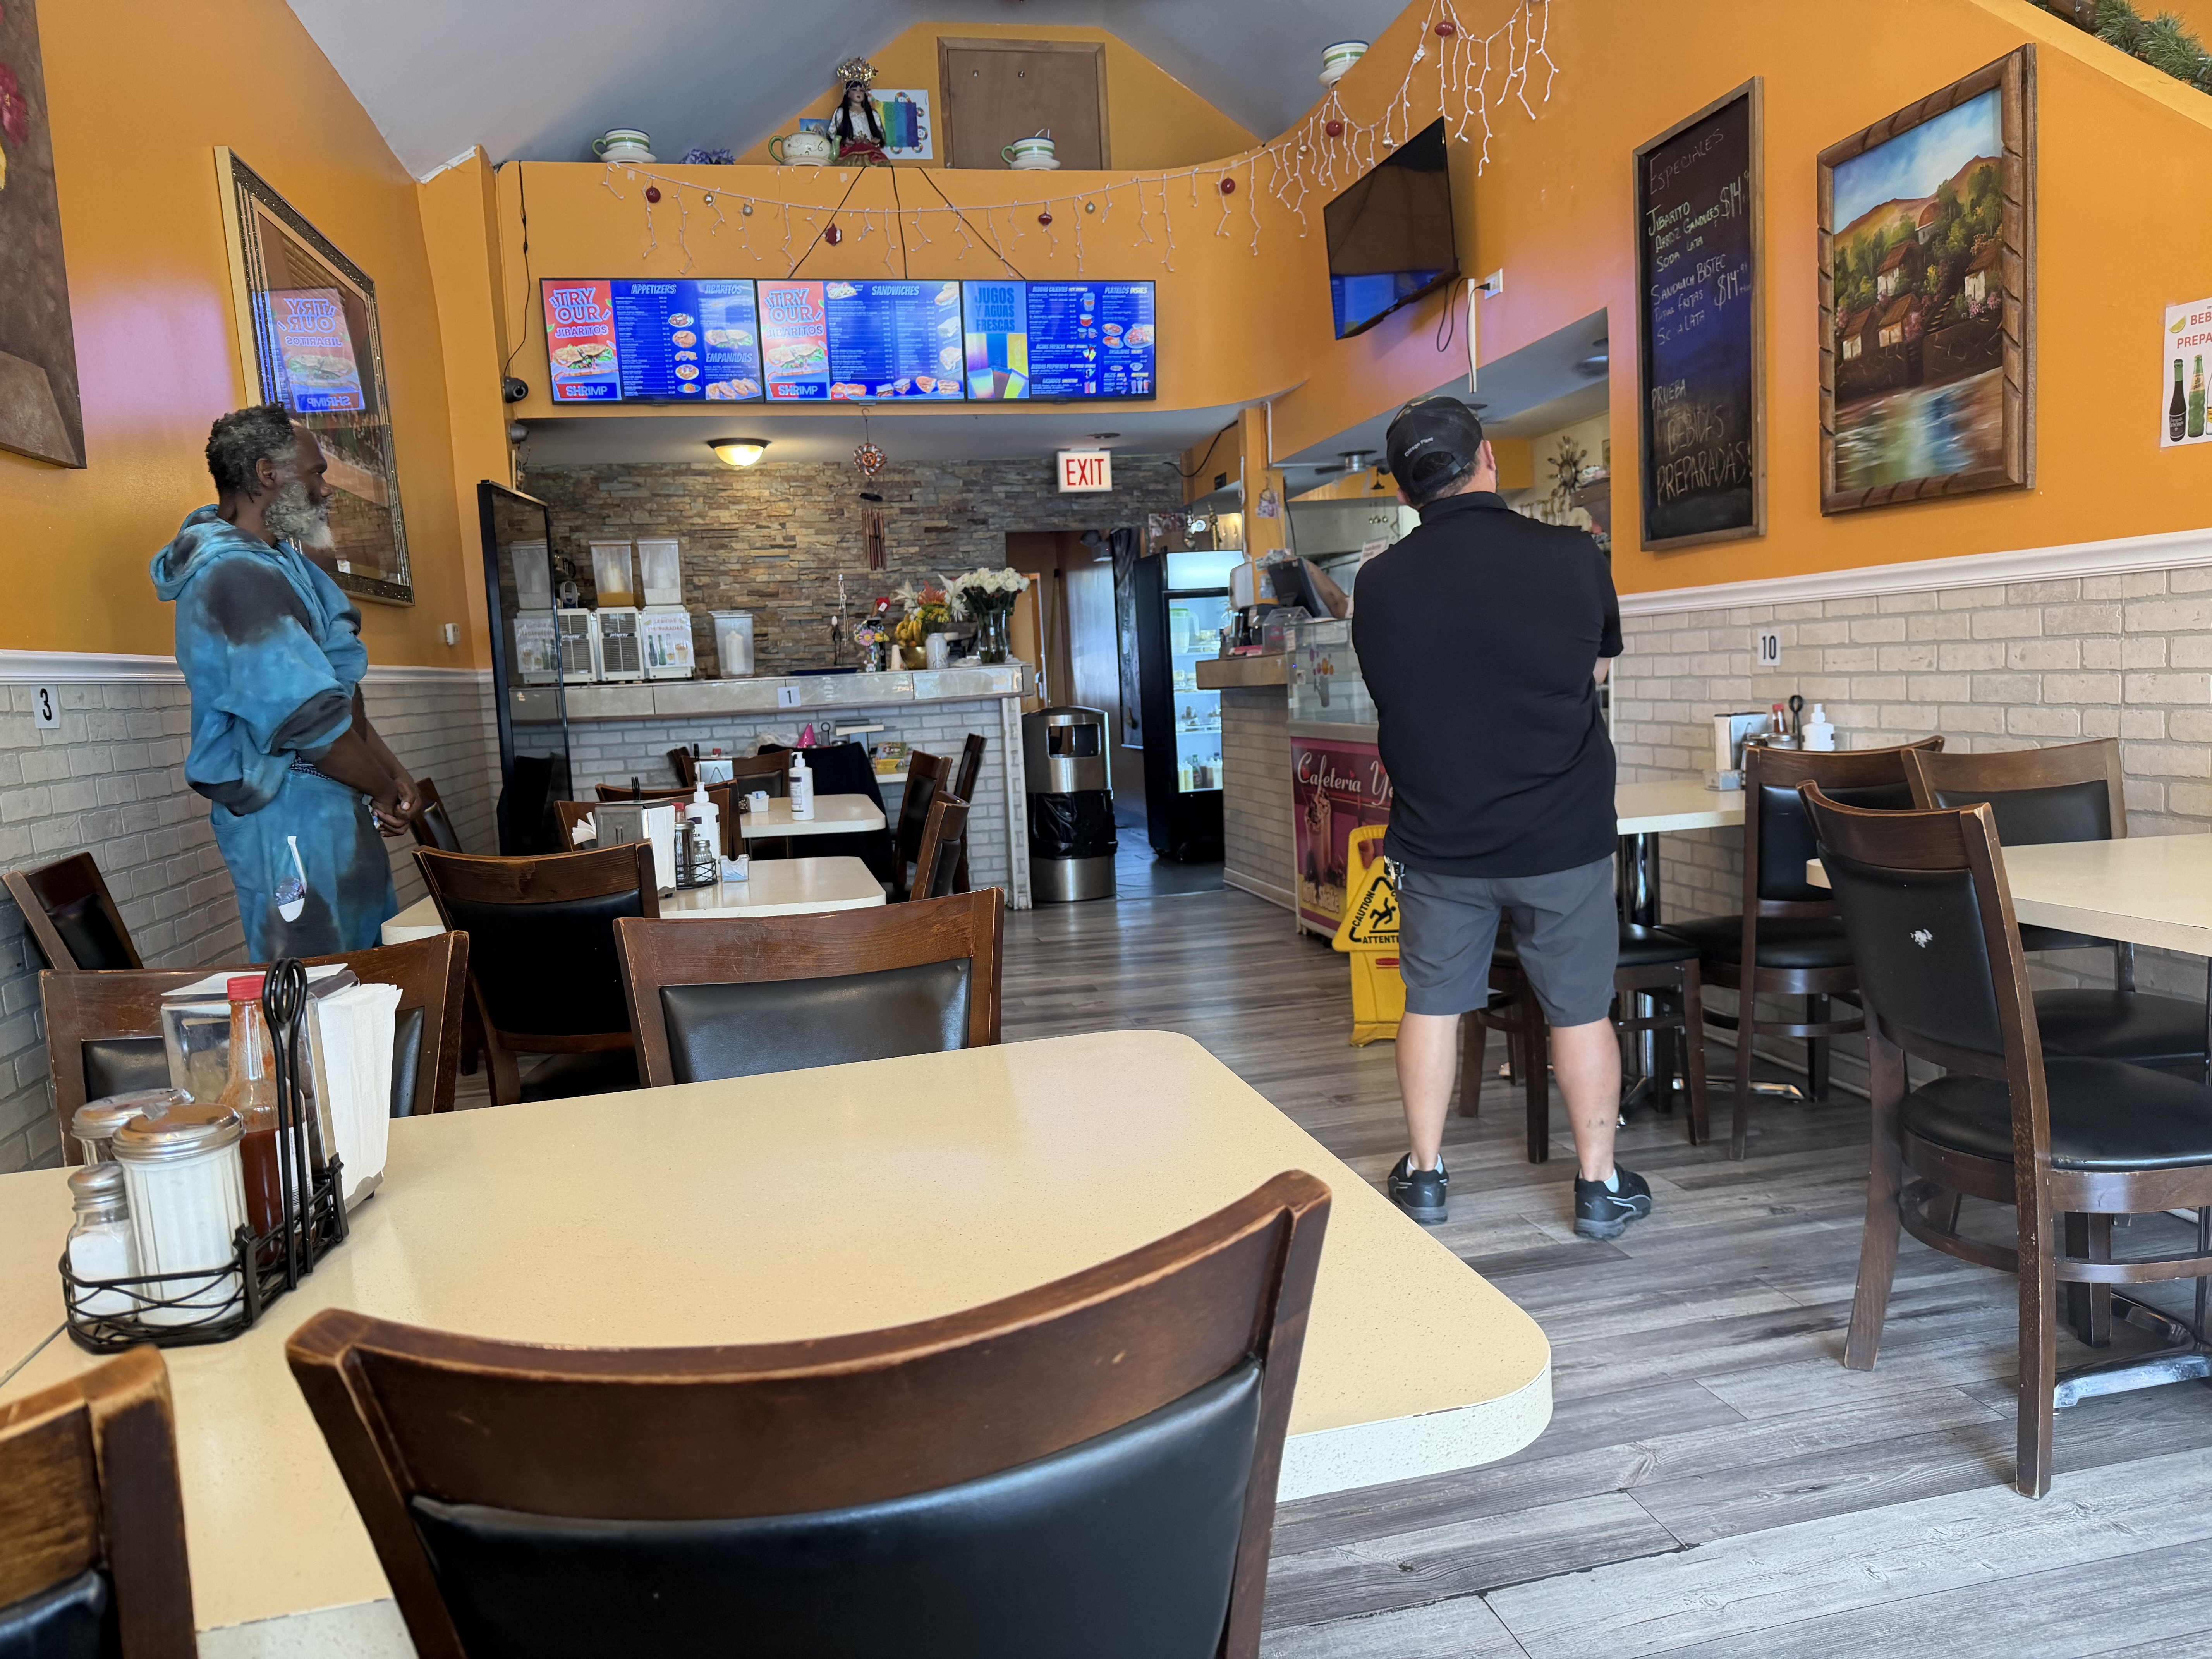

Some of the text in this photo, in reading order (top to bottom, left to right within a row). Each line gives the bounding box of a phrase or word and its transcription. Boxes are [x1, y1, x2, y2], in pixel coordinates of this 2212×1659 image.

[1650, 128, 1723, 195] ESPECIALES
[1656, 235, 1704, 272] SODA LATA
[1651, 254, 1726, 306] SANDWICH BISTEC
[631, 284, 743, 294] APPETIZERS JIBARITOS
[871, 285, 919, 296] SANDWICHES
[975, 287, 1015, 304] JUGOS
[976, 304, 1015, 318] Y AGUAS
[2190, 311, 2212, 325] BEB
[555, 325, 609, 338] JIBARITOS
[766, 325, 824, 339] JIBARITOS
[976, 319, 1015, 331] FRESCAS
[2177, 332, 2212, 349] PREPA
[706, 352, 753, 363] EMPANADAS
[566, 385, 608, 397] SHRIMP
[778, 385, 818, 396] SHRIMP
[1652, 378, 1686, 410] PRUEBA
[1404, 443, 1421, 457] Chicago
[1066, 458, 1104, 486] EXIT
[1762, 635, 1777, 660] 10
[787, 690, 792, 704] 1
[40, 688, 52, 721] 3
[1298, 752, 1362, 794] Cafeteria
[1352, 890, 1376, 927] CAUTION
[1363, 935, 1399, 944] ATTENTI
